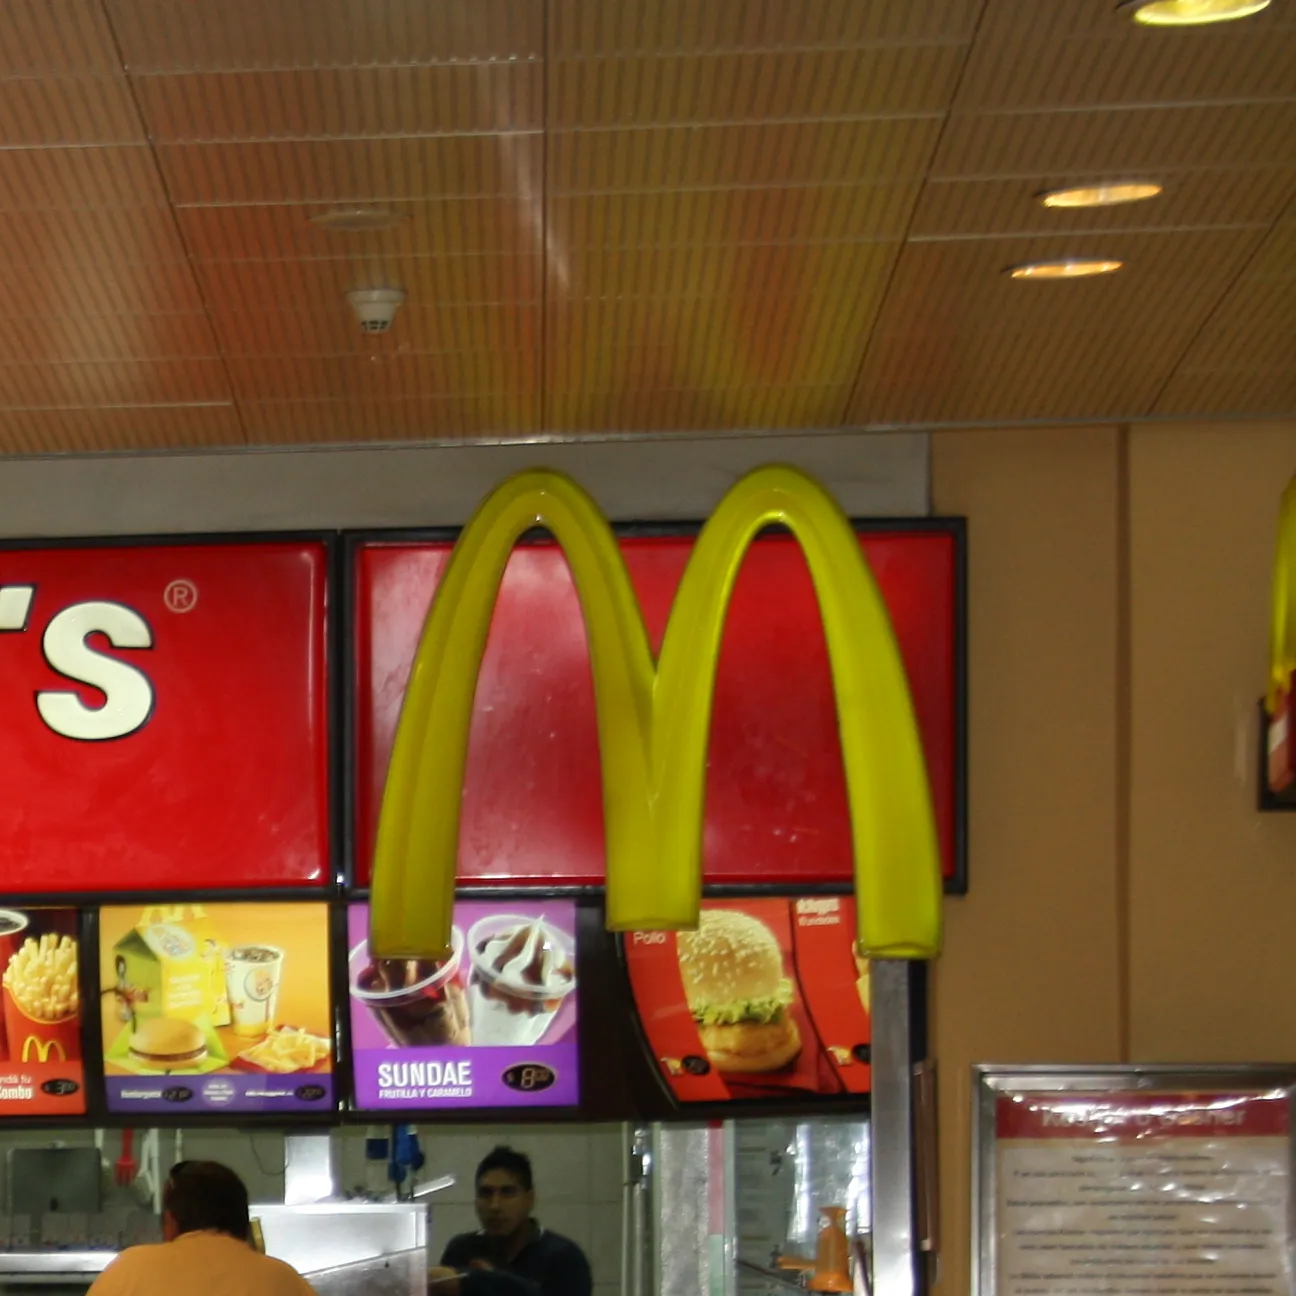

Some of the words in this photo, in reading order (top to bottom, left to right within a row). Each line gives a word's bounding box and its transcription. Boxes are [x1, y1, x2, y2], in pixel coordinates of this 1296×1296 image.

[633, 932, 666, 945] Pollo
[378, 1061, 472, 1087] SUNDAE
[379, 1089, 417, 1099] FRUTILLA
